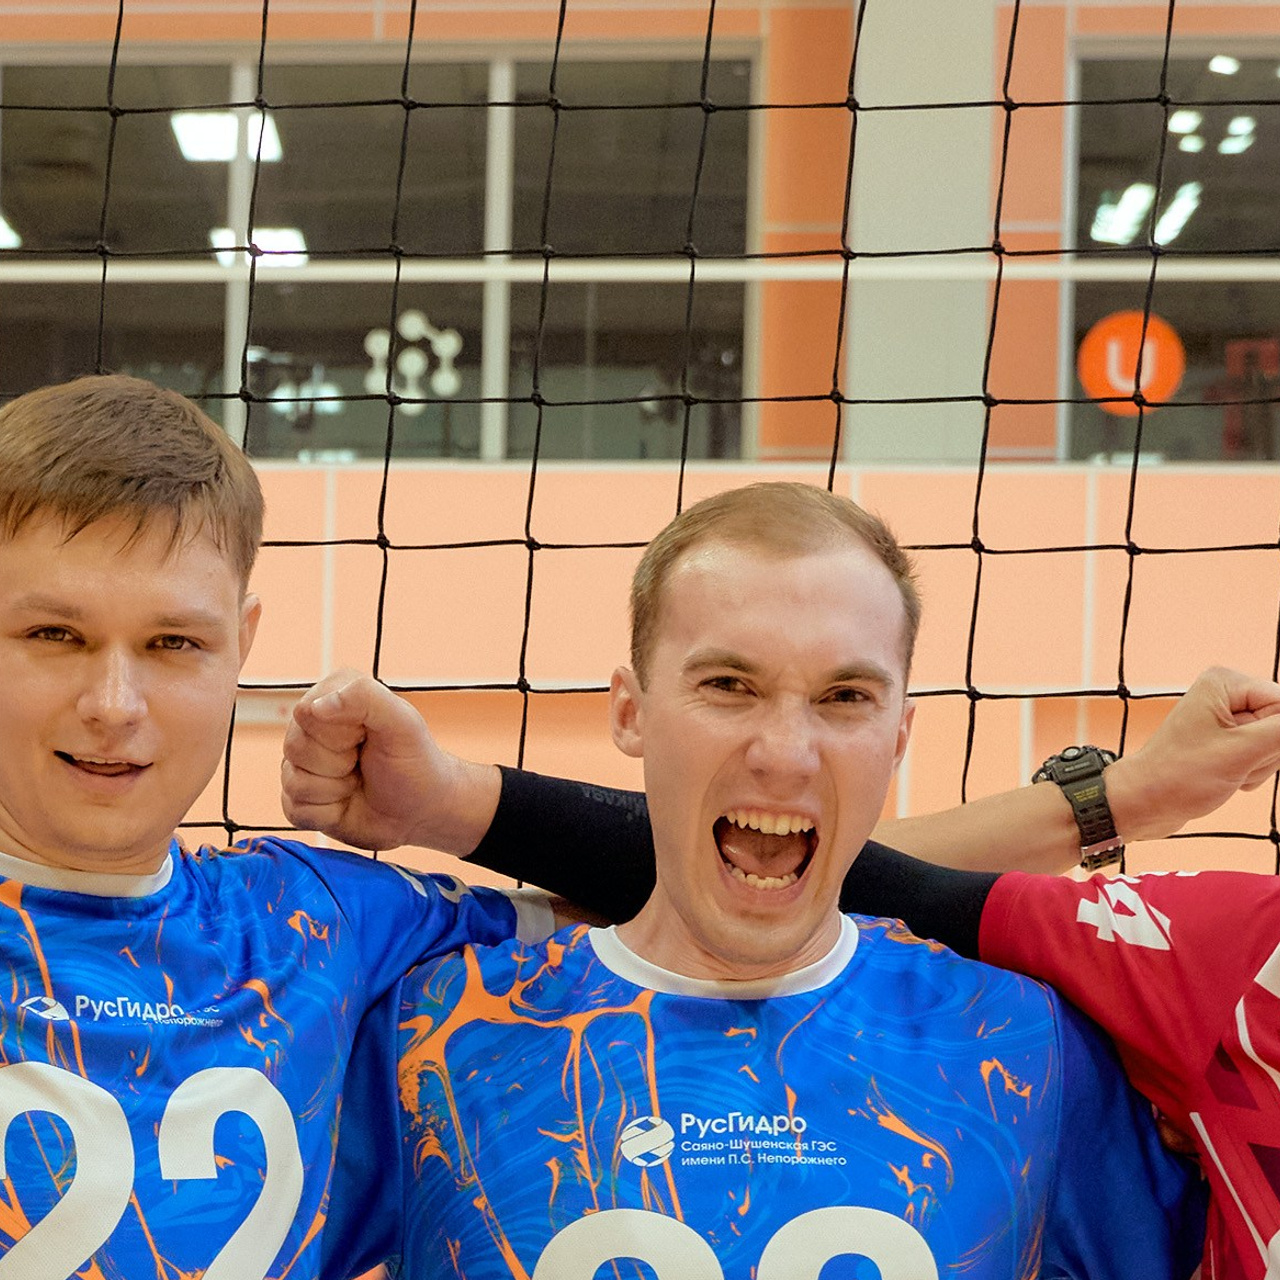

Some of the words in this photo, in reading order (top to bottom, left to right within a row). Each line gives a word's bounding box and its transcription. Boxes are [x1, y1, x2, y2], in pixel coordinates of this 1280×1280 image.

[75, 995, 185, 1022] РусГидро
[680, 1112, 807, 1138] РусГидро
[681, 1139, 809, 1152] Саяно-Шушенская
[811, 1140, 837, 1151] ГЭС
[681, 1156, 725, 1166] имени
[728, 1153, 755, 1165] П.С.
[757, 1153, 847, 1167] Непорожнего
